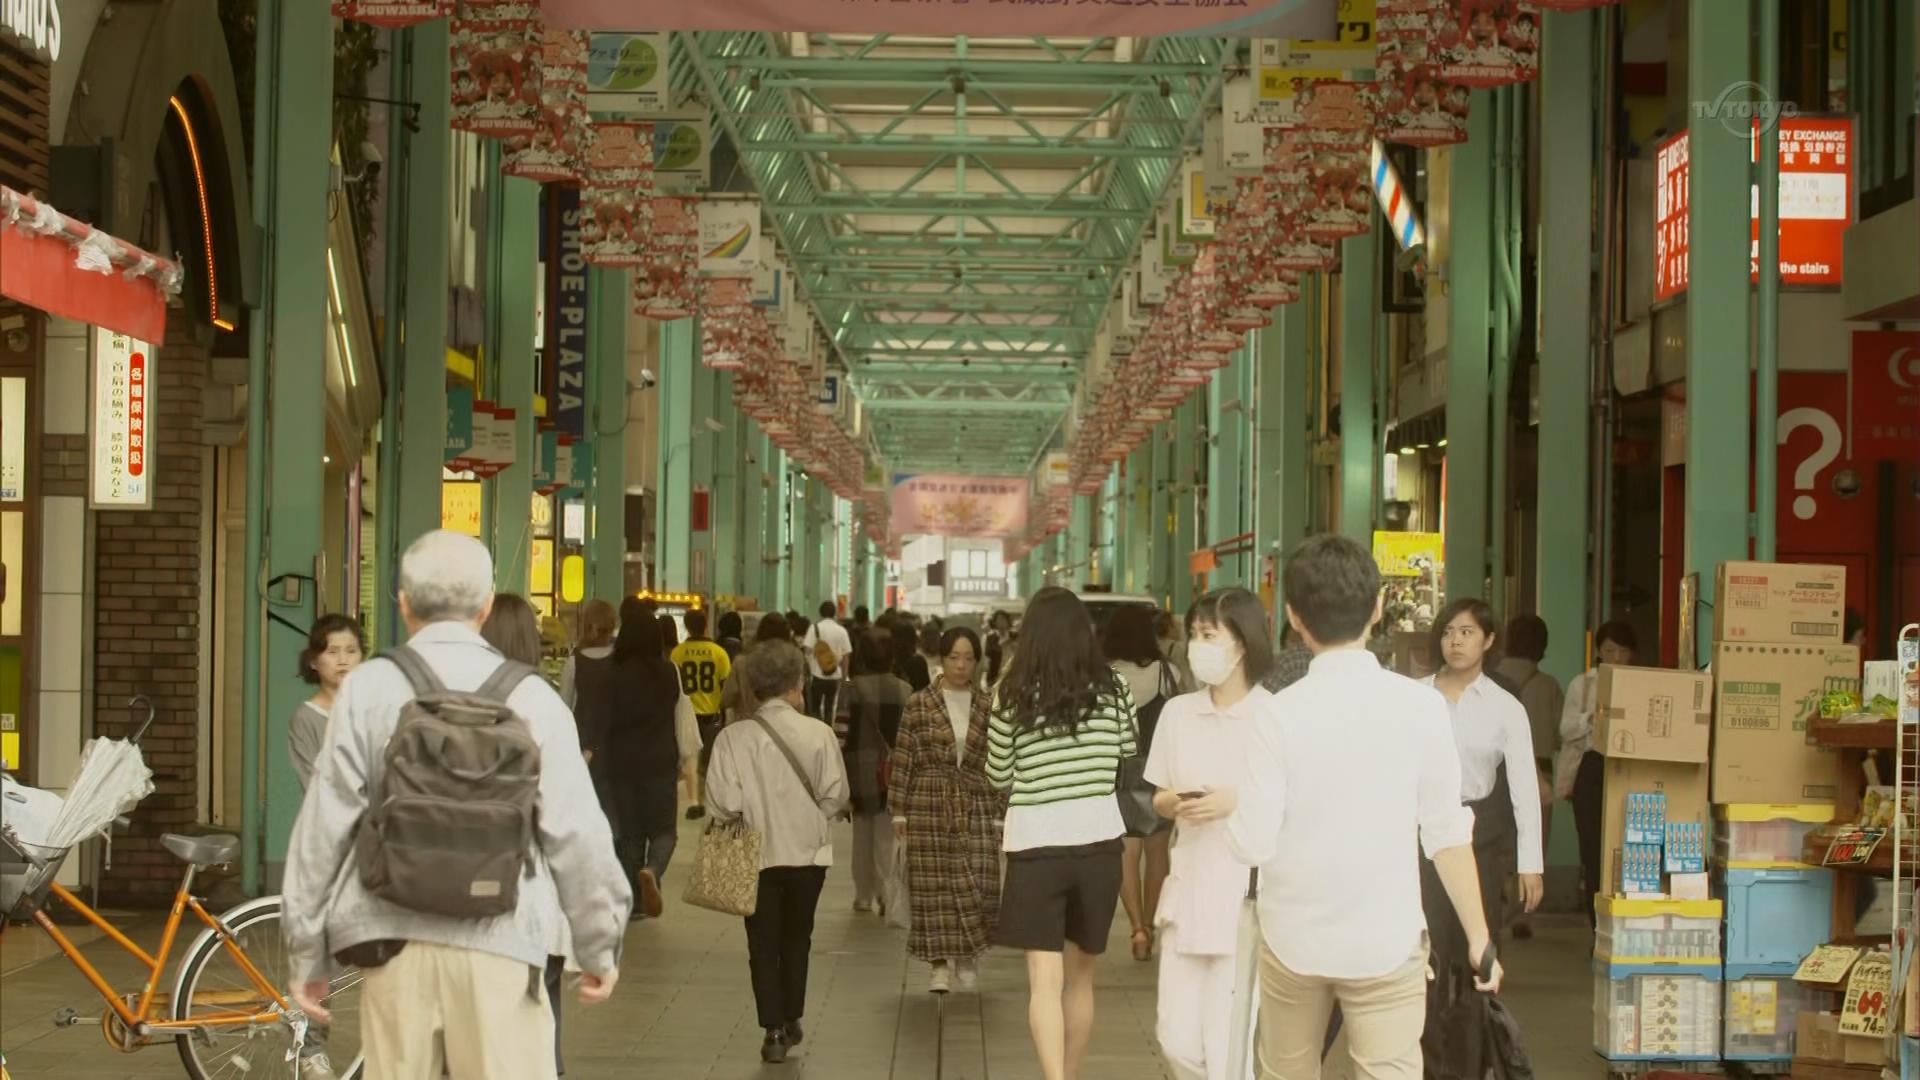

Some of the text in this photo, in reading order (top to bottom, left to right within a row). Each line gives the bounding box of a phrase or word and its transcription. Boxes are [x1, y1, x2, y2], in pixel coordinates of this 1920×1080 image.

[1793, 130, 1847, 141] EXCHANGE
[1779, 262, 1830, 274] the stairs
[130, 367, 143, 465] 各種保険取扱
[682, 661, 716, 694] 88
